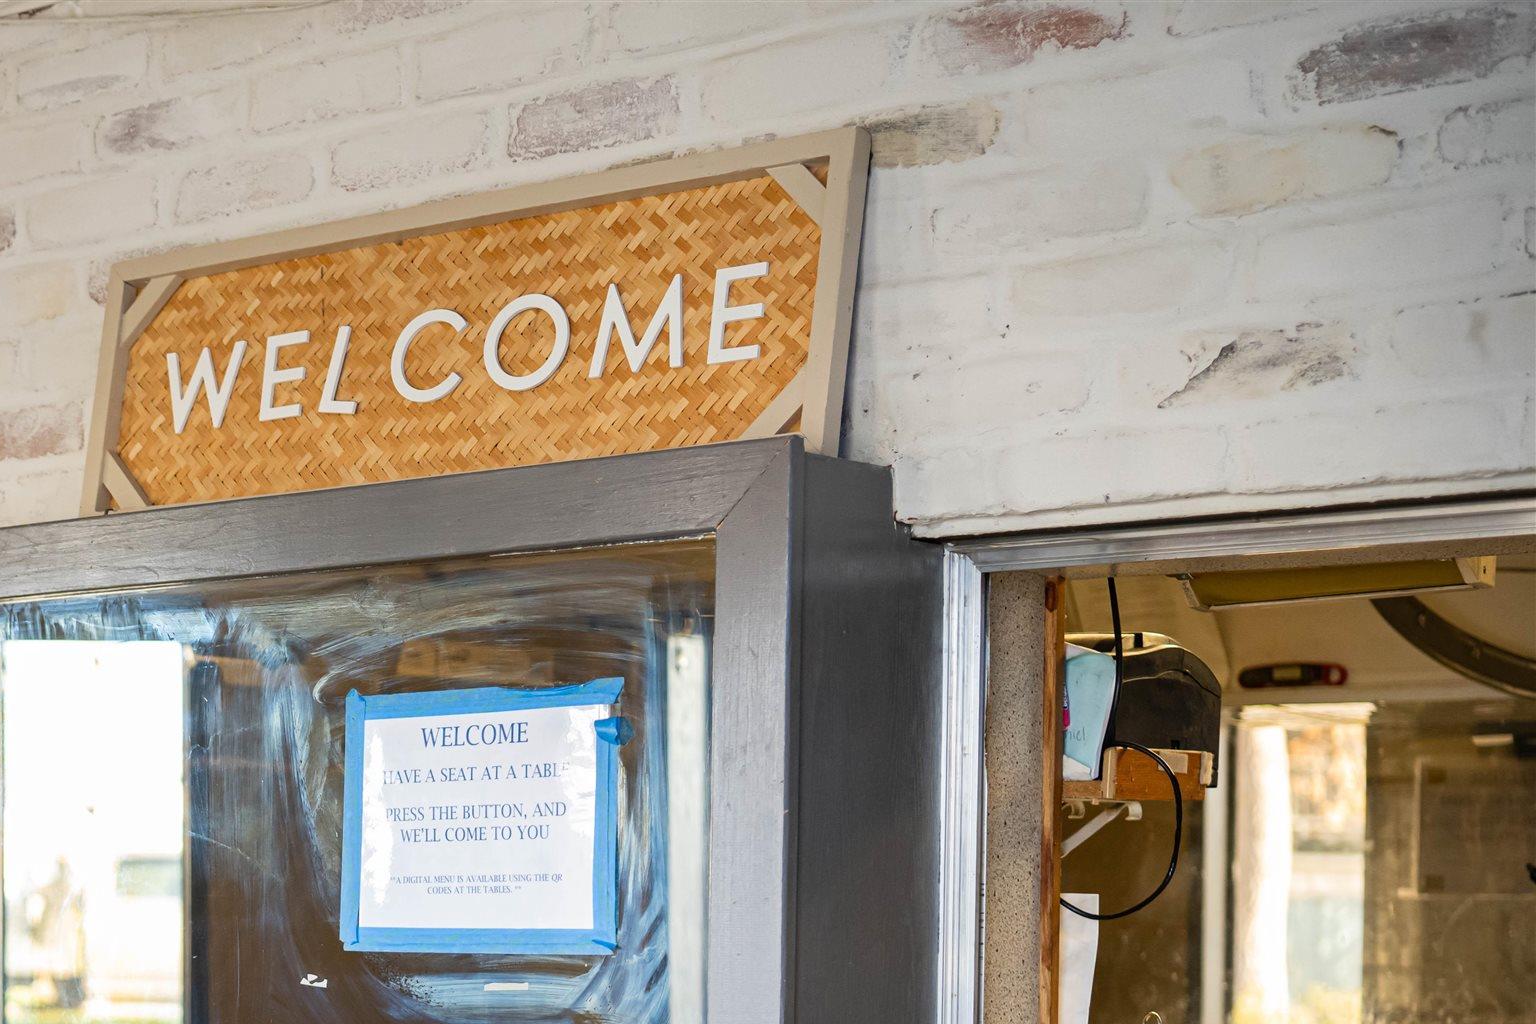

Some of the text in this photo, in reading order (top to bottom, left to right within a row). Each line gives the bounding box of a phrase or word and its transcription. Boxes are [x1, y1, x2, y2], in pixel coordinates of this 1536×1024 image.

[166, 261, 770, 434] WELCOME
[421, 722, 529, 748] WELCOME
[383, 769, 421, 784] HAVE
[425, 769, 436, 783] A
[440, 766, 478, 782] SEAT
[481, 765, 502, 780] AT
[506, 765, 517, 779] A
[386, 801, 567, 822] PRESS THE BUTTON, AND
[400, 824, 550, 843] WE'LL COME TO YOU
[403, 875, 433, 884] DIGITAL
[434, 875, 455, 883] MENU
[457, 875, 464, 883] IS
[465, 874, 507, 883] AVAILABLE
[508, 874, 532, 883] USING
[534, 874, 549, 882] THE
[551, 873, 563, 884] QR
[427, 886, 452, 895] CODES
[453, 886, 465, 894] AT
[466, 885, 482, 894] THE
[483, 885, 513, 894] TABLES.
